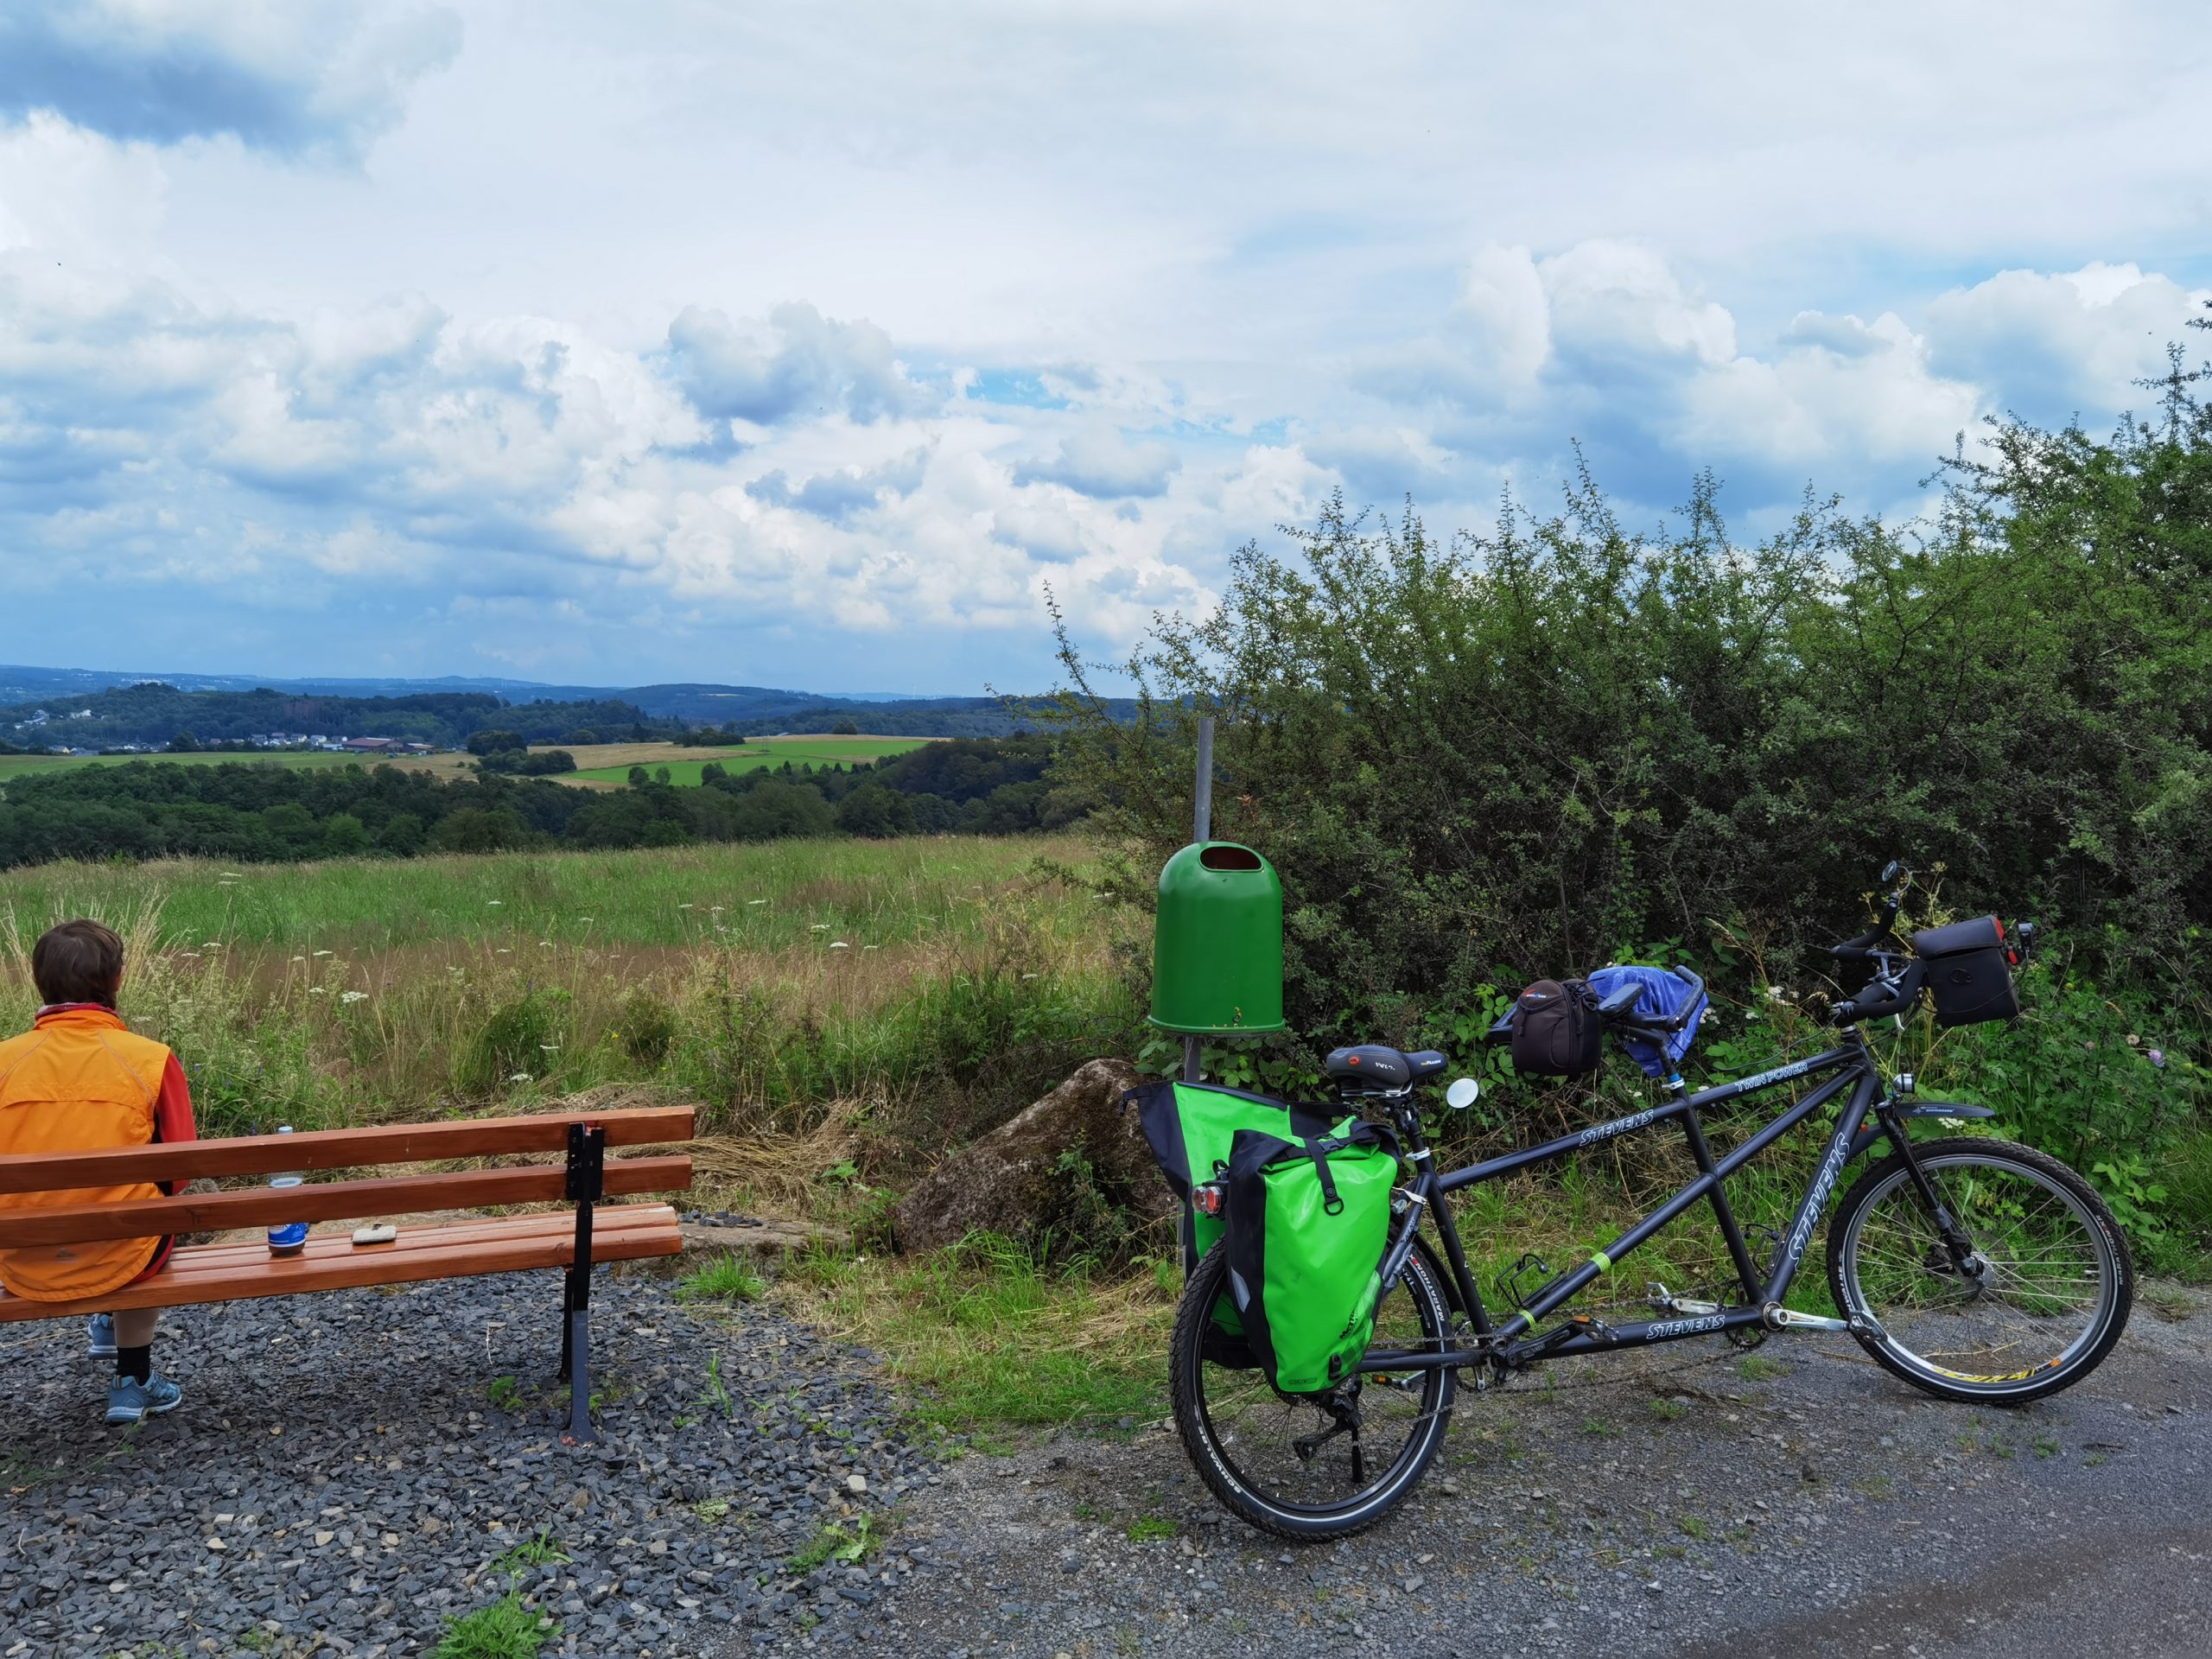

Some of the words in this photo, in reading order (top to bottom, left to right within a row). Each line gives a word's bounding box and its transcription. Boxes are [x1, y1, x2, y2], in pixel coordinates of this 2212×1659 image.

[1734, 1074, 1767, 1092] TWIN
[1768, 1061, 1808, 1083] POWER
[1579, 1109, 1654, 1147] STEVENS
[1788, 1132, 1850, 1273] STEVENS
[1416, 1263, 1445, 1321] MARATHON
[1646, 1314, 1726, 1339] STEVENS
[1198, 1426, 1242, 1494] SCHWALBE
